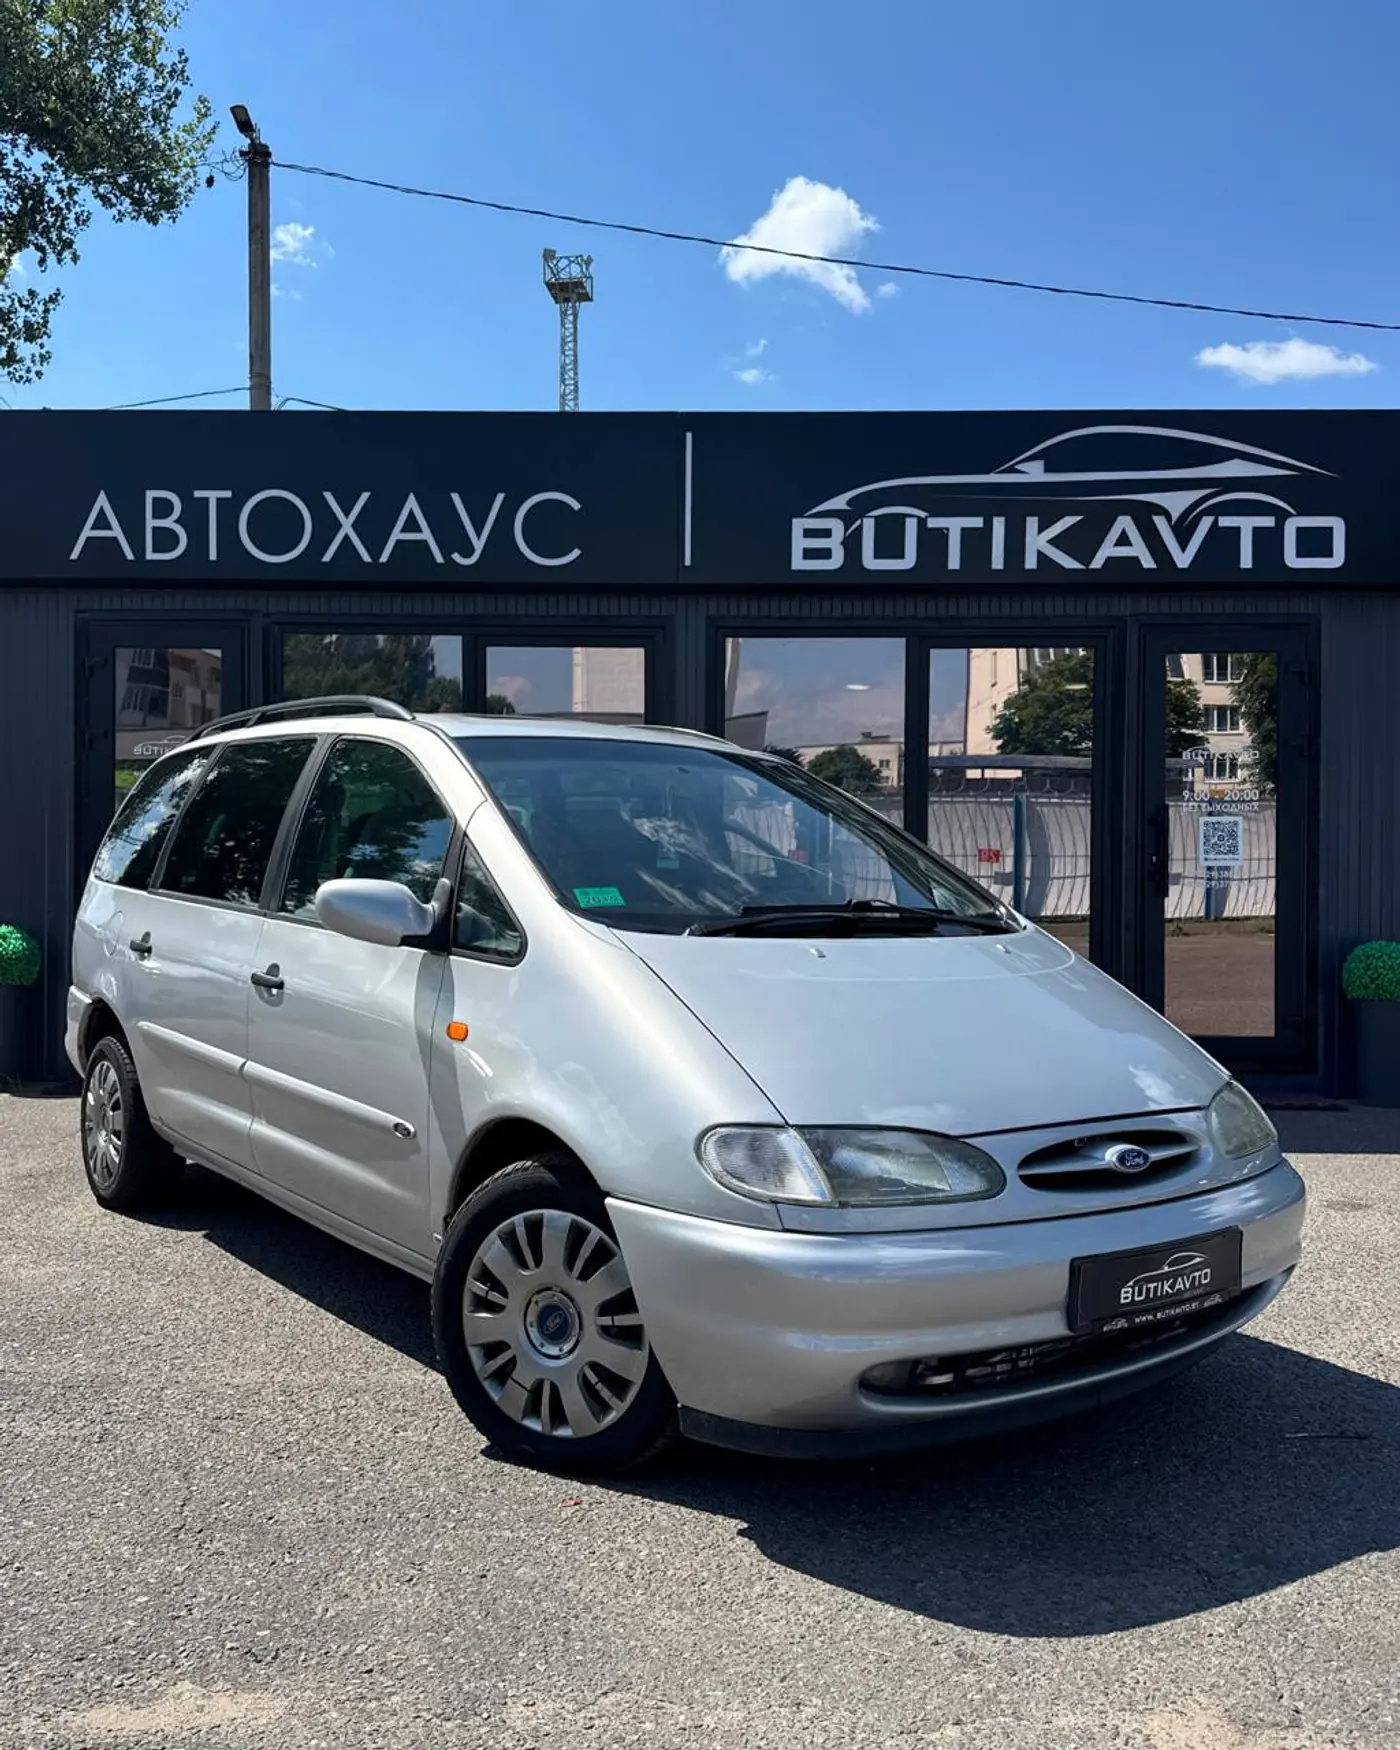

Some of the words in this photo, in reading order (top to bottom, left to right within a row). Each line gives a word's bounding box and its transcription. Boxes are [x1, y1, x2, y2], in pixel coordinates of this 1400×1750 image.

[69, 489, 581, 566] АВТОХАУС
[790, 515, 1346, 571] BUTIKAVTO
[1182, 790, 1210, 801] 9:00
[1224, 789, 1259, 801] 20:00
[1119, 1268, 1211, 1305] BUTIKAVTO
